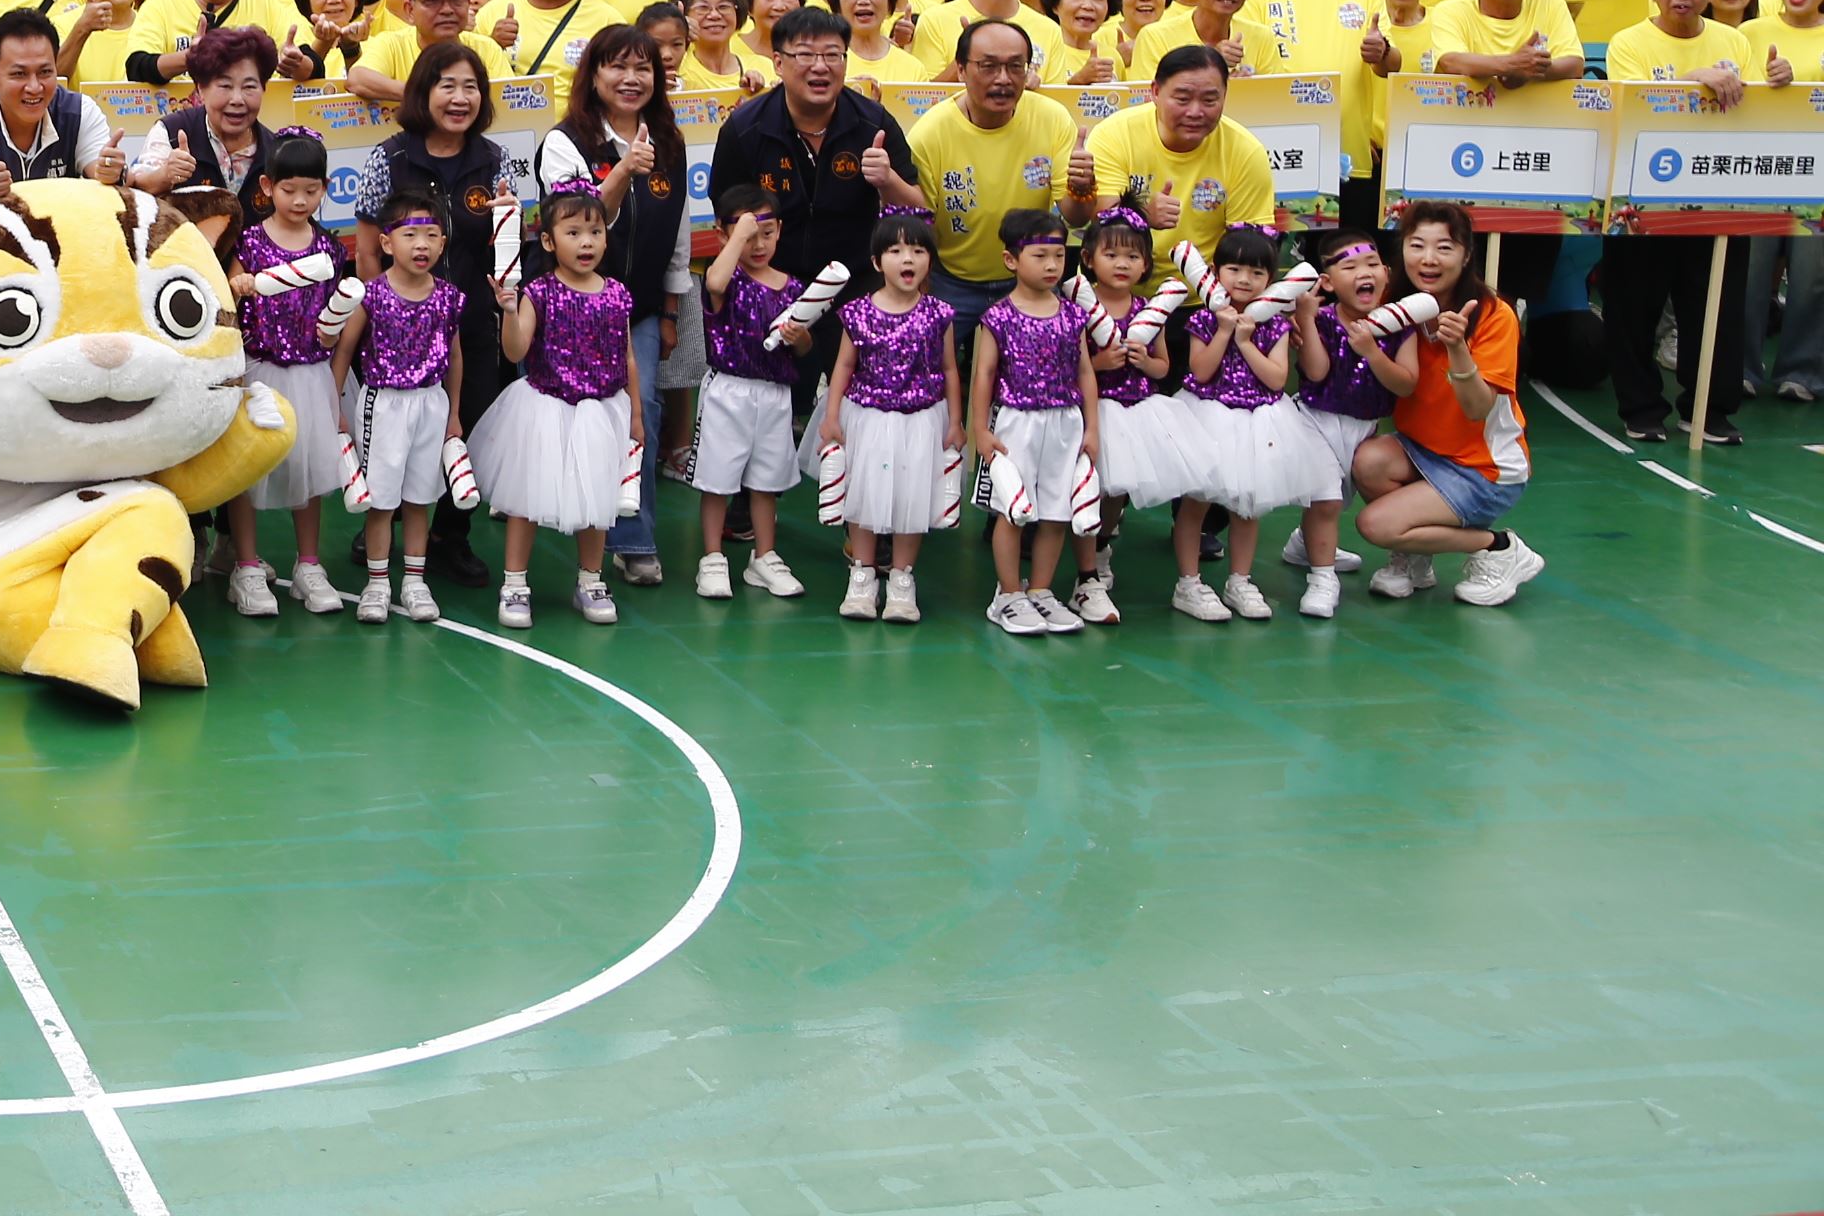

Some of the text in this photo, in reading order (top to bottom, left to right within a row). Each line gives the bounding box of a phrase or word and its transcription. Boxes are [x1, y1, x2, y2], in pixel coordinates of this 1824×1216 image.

[1492, 150, 1551, 172] 上苗里
[1690, 154, 1815, 176] 苗栗市福麗里
[331, 175, 358, 197] 10
[692, 171, 708, 192] 9
[943, 171, 970, 234] 魏誠良
